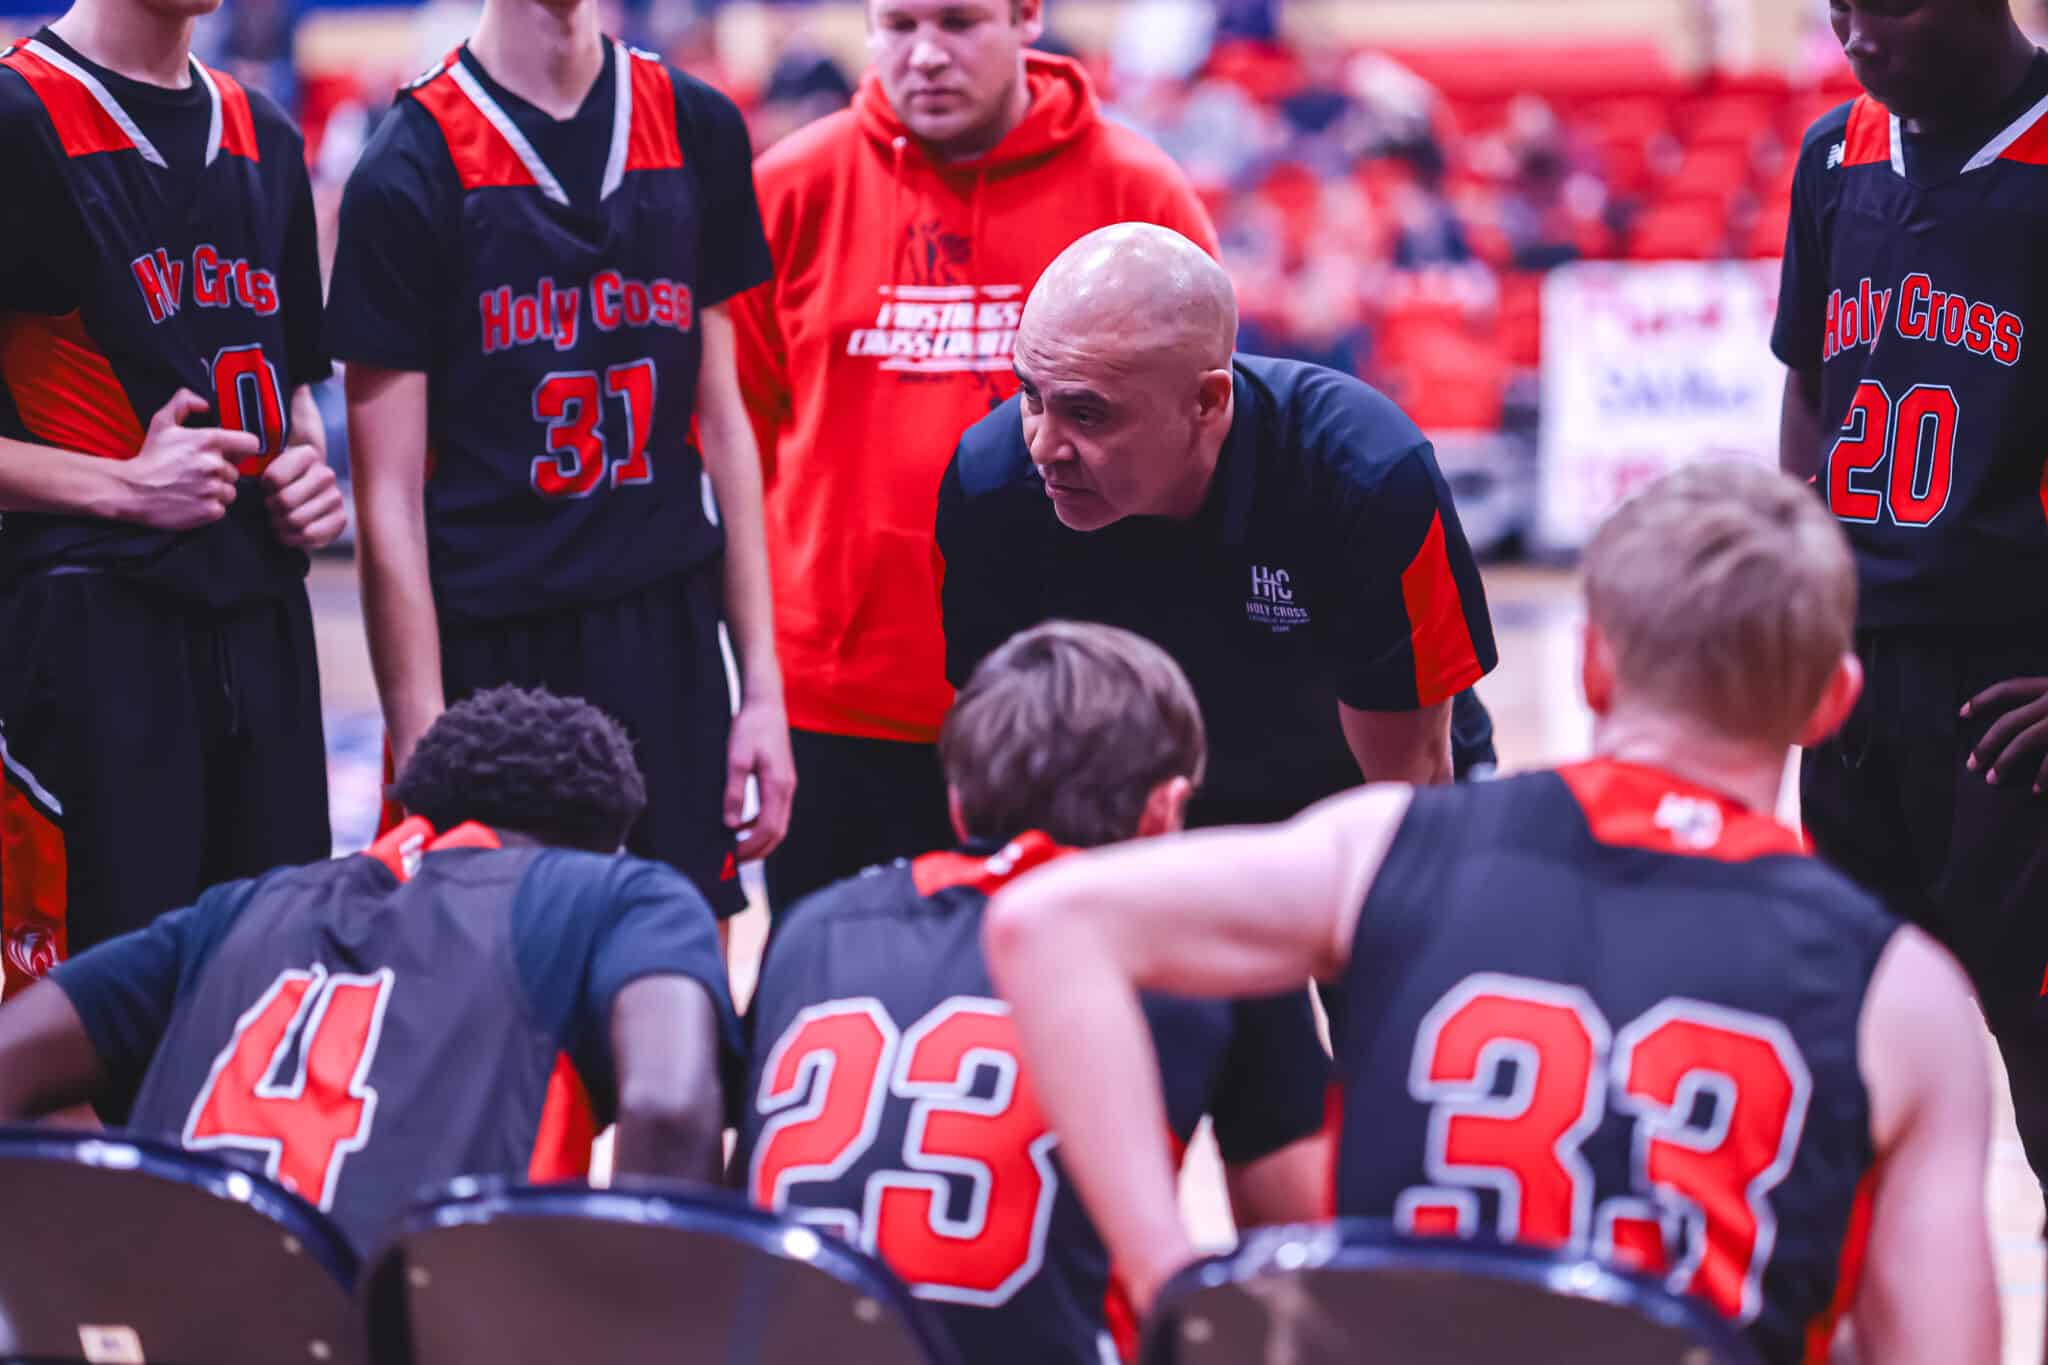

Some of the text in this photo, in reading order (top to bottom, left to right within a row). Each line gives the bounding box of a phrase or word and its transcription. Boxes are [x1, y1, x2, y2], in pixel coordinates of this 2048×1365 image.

[479, 268, 693, 354] Holy Coss
[1822, 277, 1893, 363] Holy
[1896, 272, 2024, 367] Cross
[530, 357, 657, 499] 31
[1826, 378, 1960, 528] 20
[1246, 602, 1308, 618] HOLY CROSS
[181, 963, 395, 1212] 4
[748, 995, 1059, 1308] 23
[1393, 972, 1813, 1326] 33
